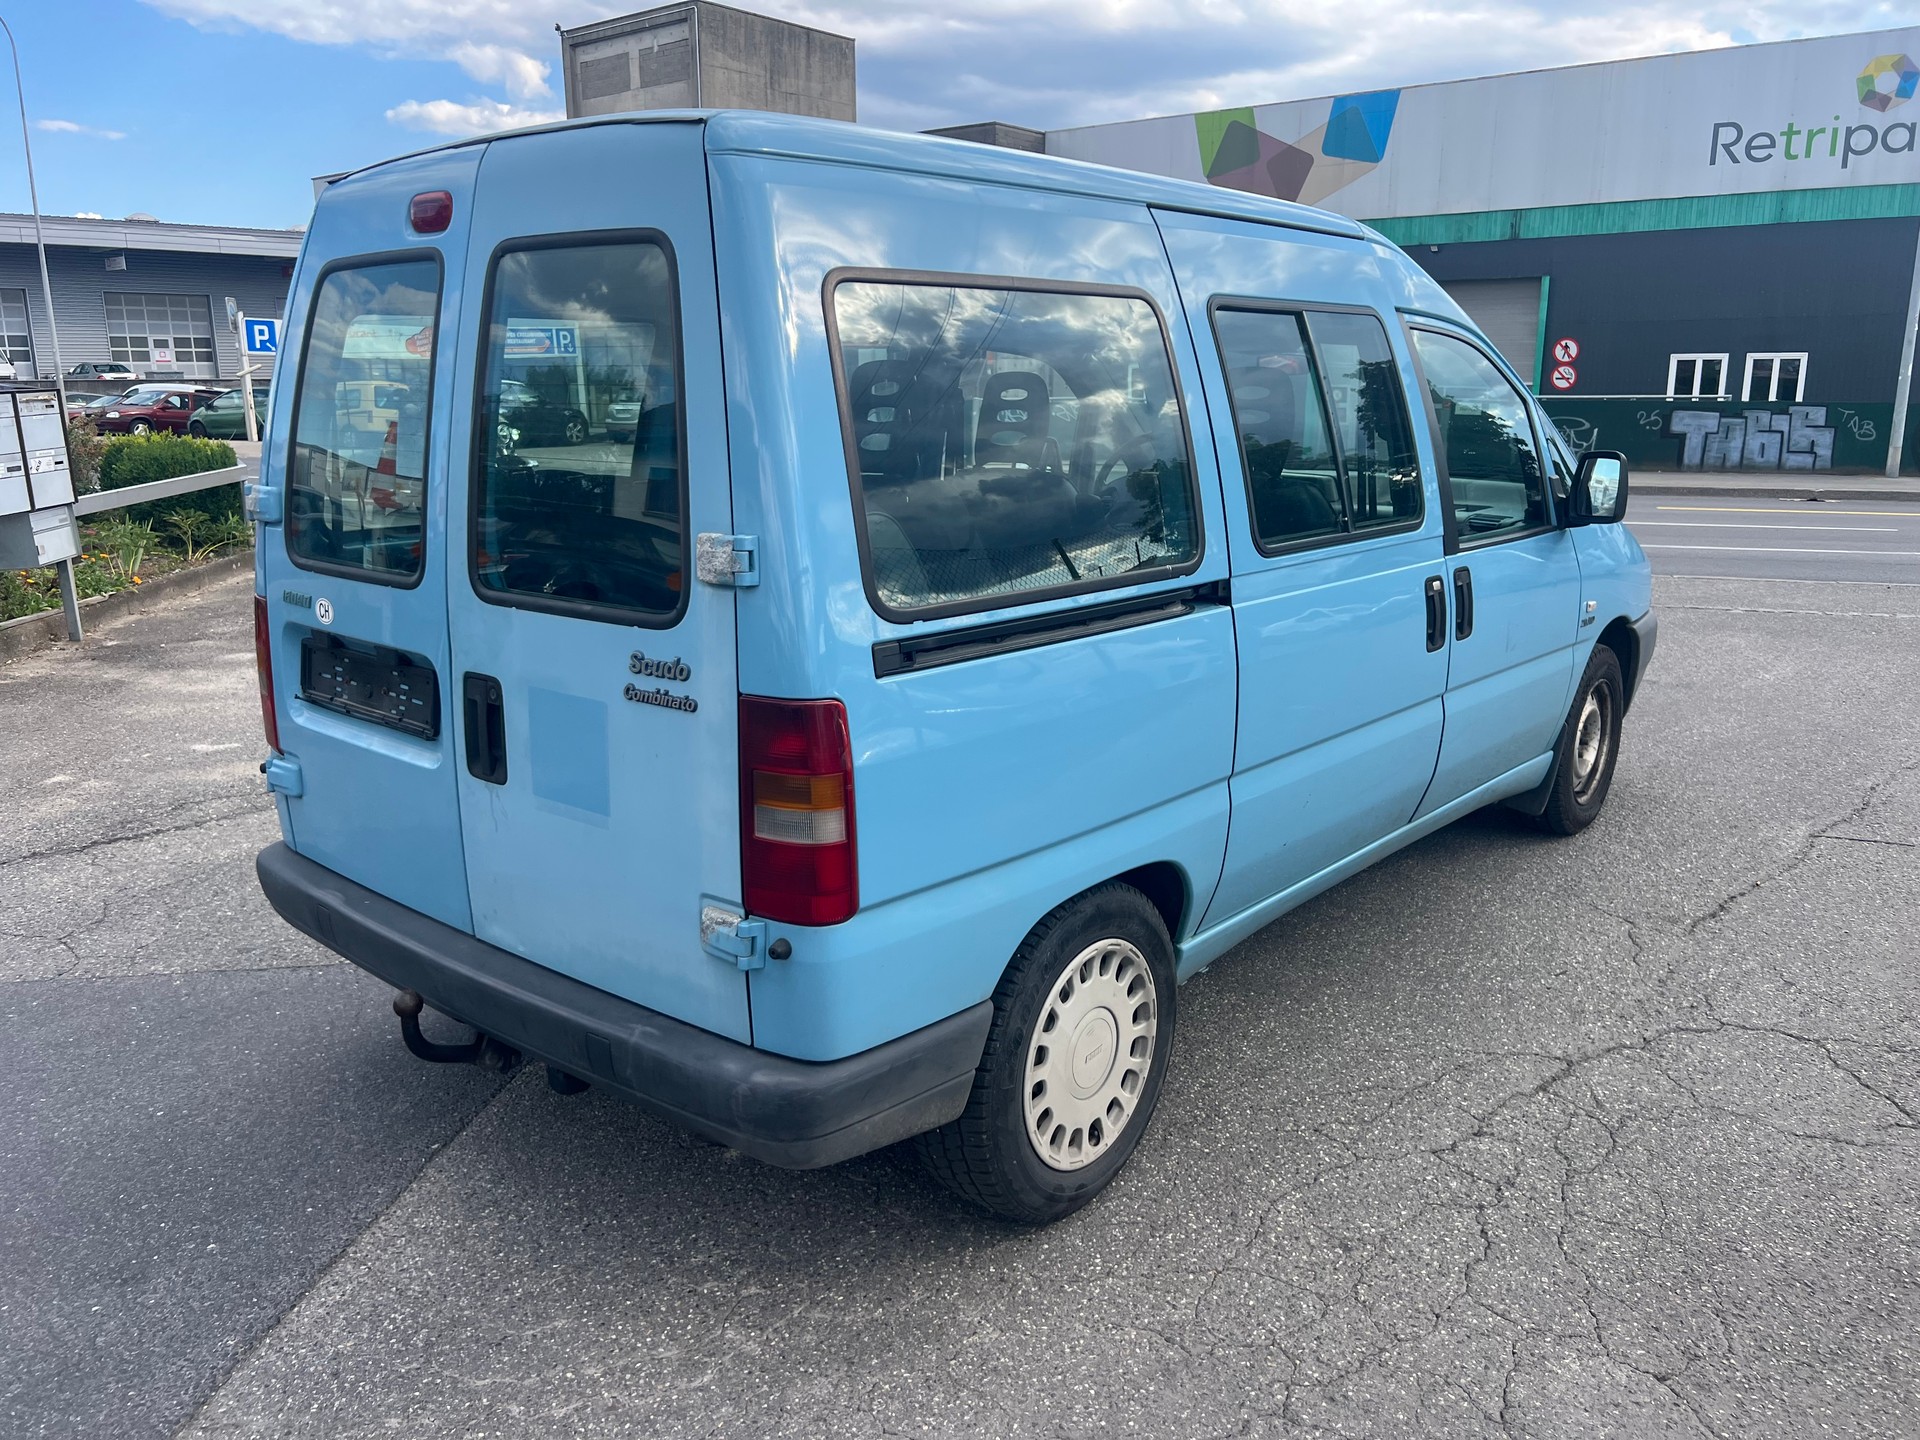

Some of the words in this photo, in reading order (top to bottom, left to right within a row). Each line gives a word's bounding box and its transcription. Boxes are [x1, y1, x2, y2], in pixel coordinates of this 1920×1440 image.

[1709, 115, 1918, 170] Retripa
[253, 325, 270, 349] P
[560, 331, 571, 351] P
[318, 602, 331, 620] CH
[629, 650, 692, 682] Scudo
[623, 683, 699, 713] Combinato
